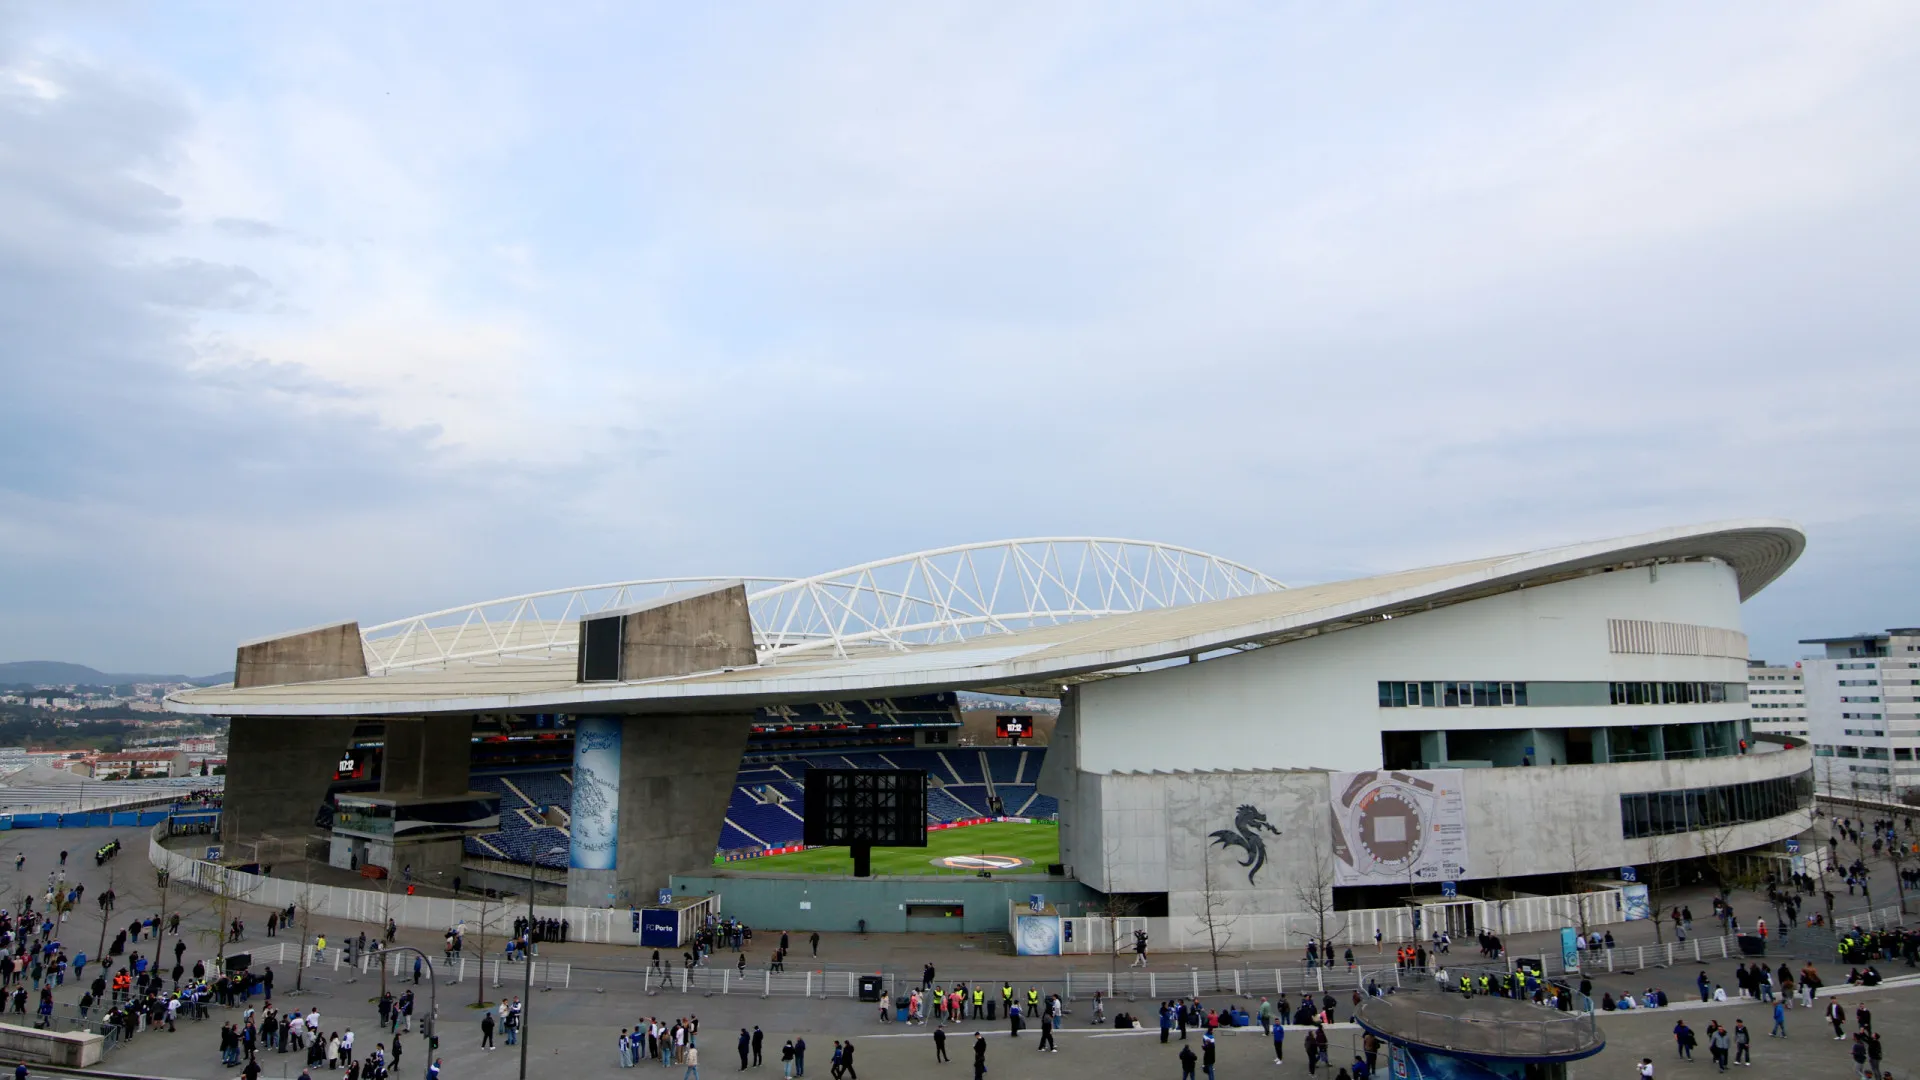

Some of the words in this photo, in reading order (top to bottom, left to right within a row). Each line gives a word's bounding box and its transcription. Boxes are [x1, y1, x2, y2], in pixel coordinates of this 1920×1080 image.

[209, 851, 220, 859] 22
[1622, 872, 1636, 881] 26
[1444, 888, 1456, 897] 25
[661, 894, 672, 904] 23
[1031, 901, 1038, 910] 24
[655, 924, 673, 932] Porto
